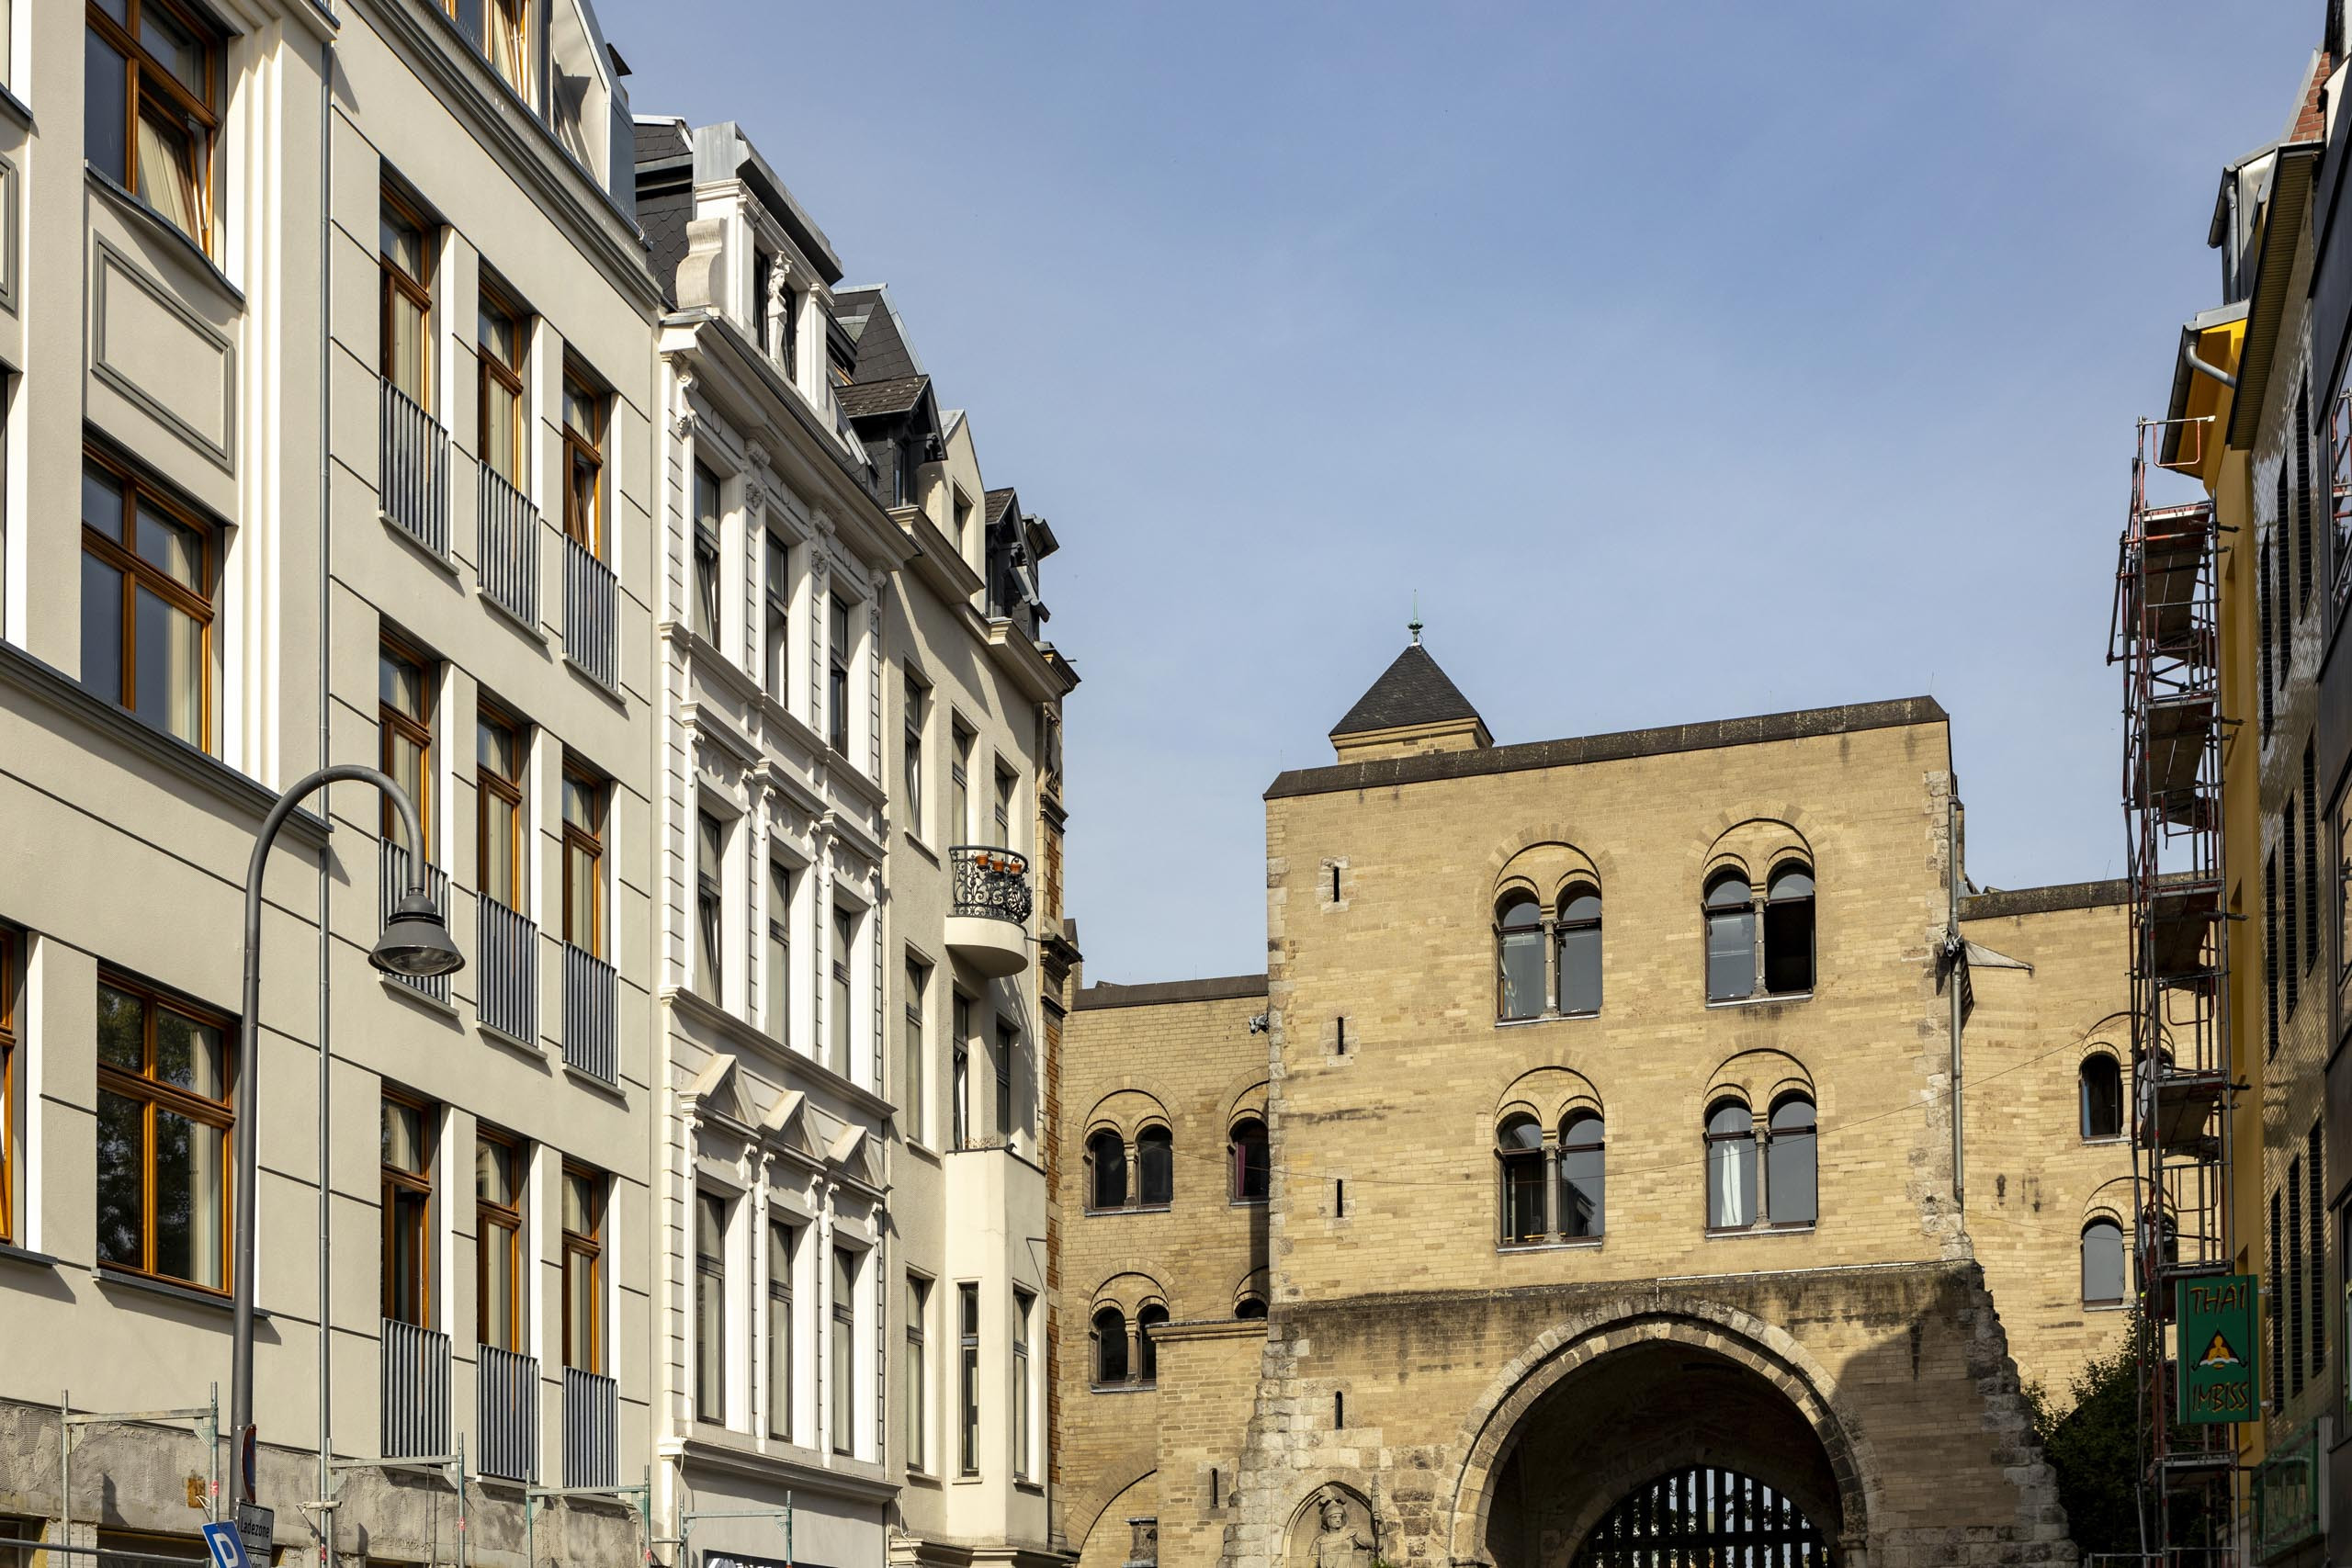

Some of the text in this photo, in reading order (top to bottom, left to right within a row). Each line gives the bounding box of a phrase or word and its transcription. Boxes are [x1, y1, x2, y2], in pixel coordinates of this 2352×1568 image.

[2190, 1283, 2247, 1314] THAI
[2192, 1382, 2248, 1413] IMBISS
[240, 1516, 270, 1539] Ladezone
[212, 1532, 239, 1568] P
